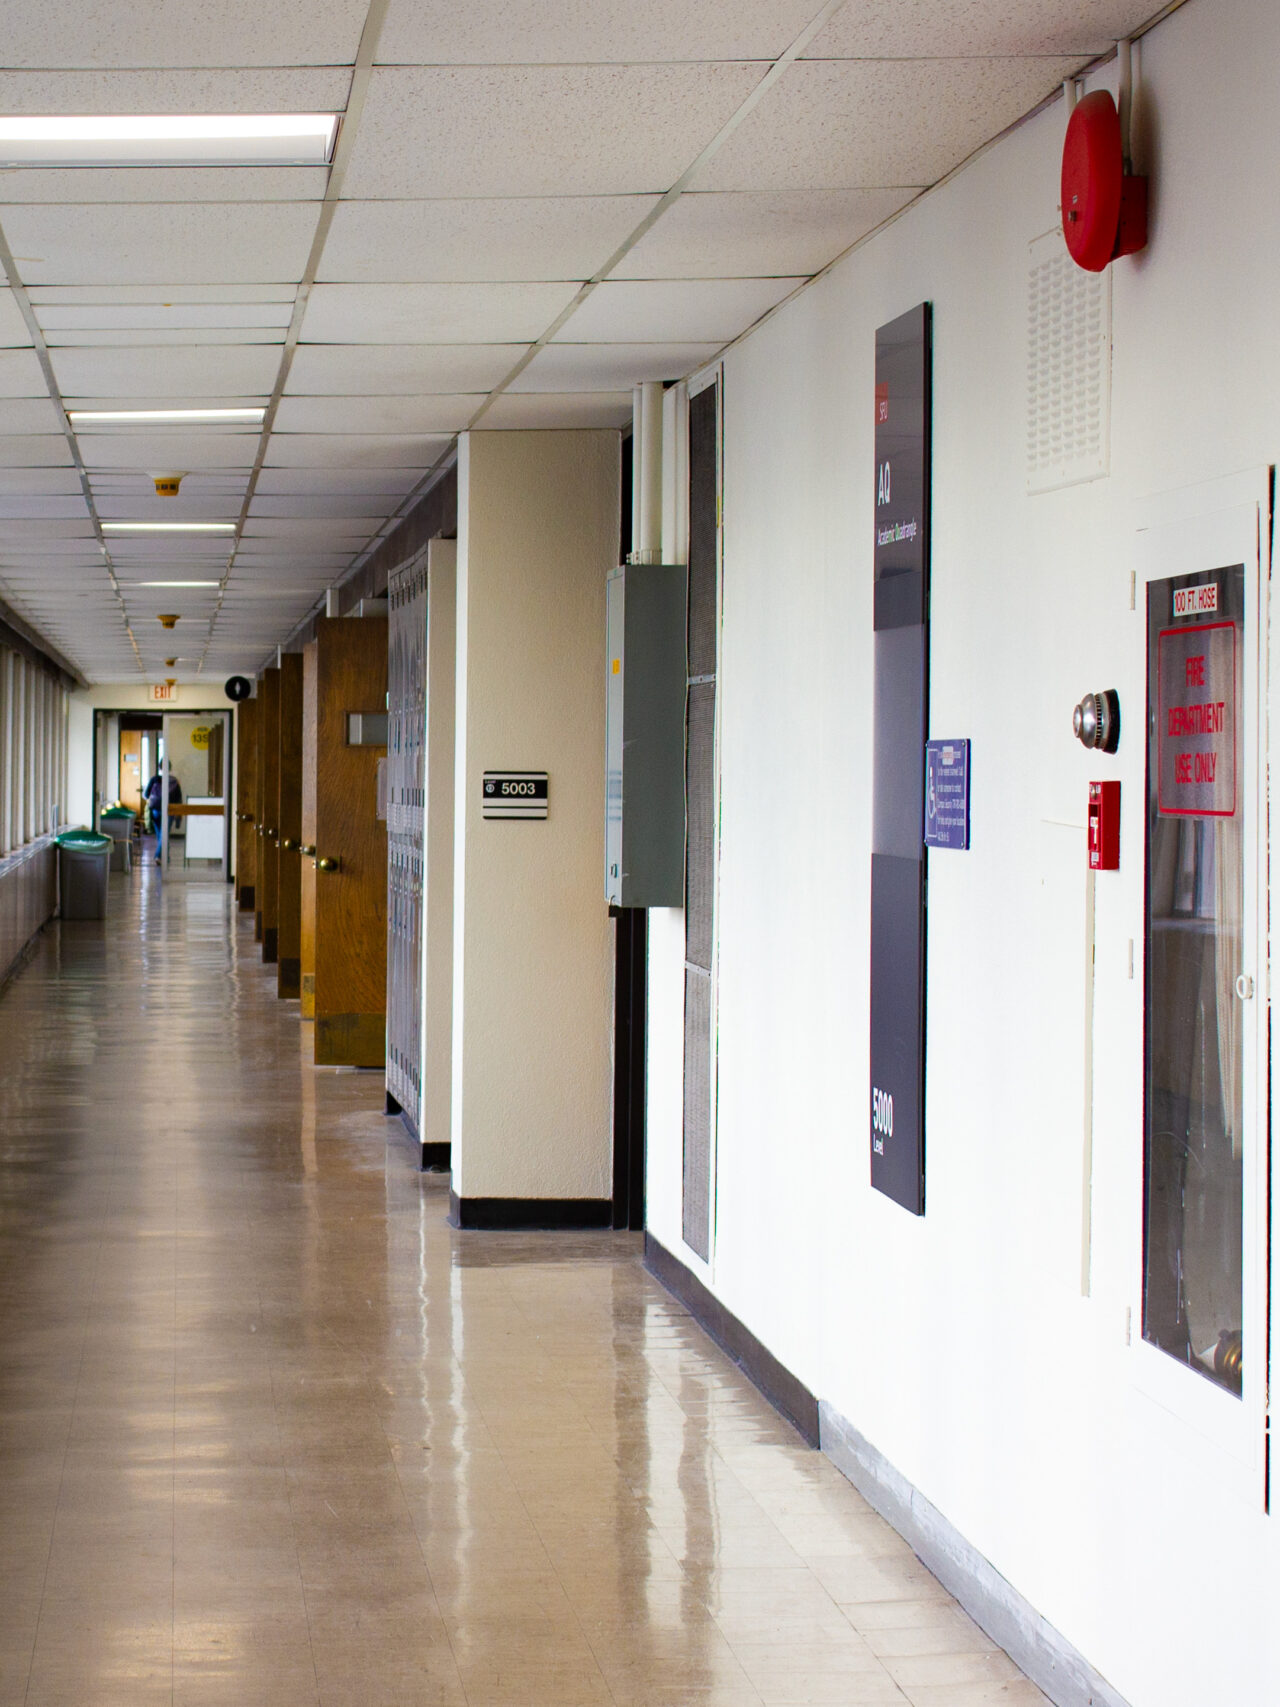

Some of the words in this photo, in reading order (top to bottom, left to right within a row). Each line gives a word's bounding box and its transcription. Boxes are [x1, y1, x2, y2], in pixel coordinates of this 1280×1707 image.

[877, 461, 891, 506] AQ
[1175, 592, 1186, 612] 100
[1187, 590, 1197, 610] FT.
[1198, 587, 1216, 609] HOSE
[1185, 656, 1205, 688] FIRE
[1168, 702, 1225, 737] DEPARTMENT
[1174, 753, 1193, 784] USE
[1194, 752, 1217, 783] ONLY
[501, 782, 536, 795] 5003
[873, 1087, 893, 1137] 5000
